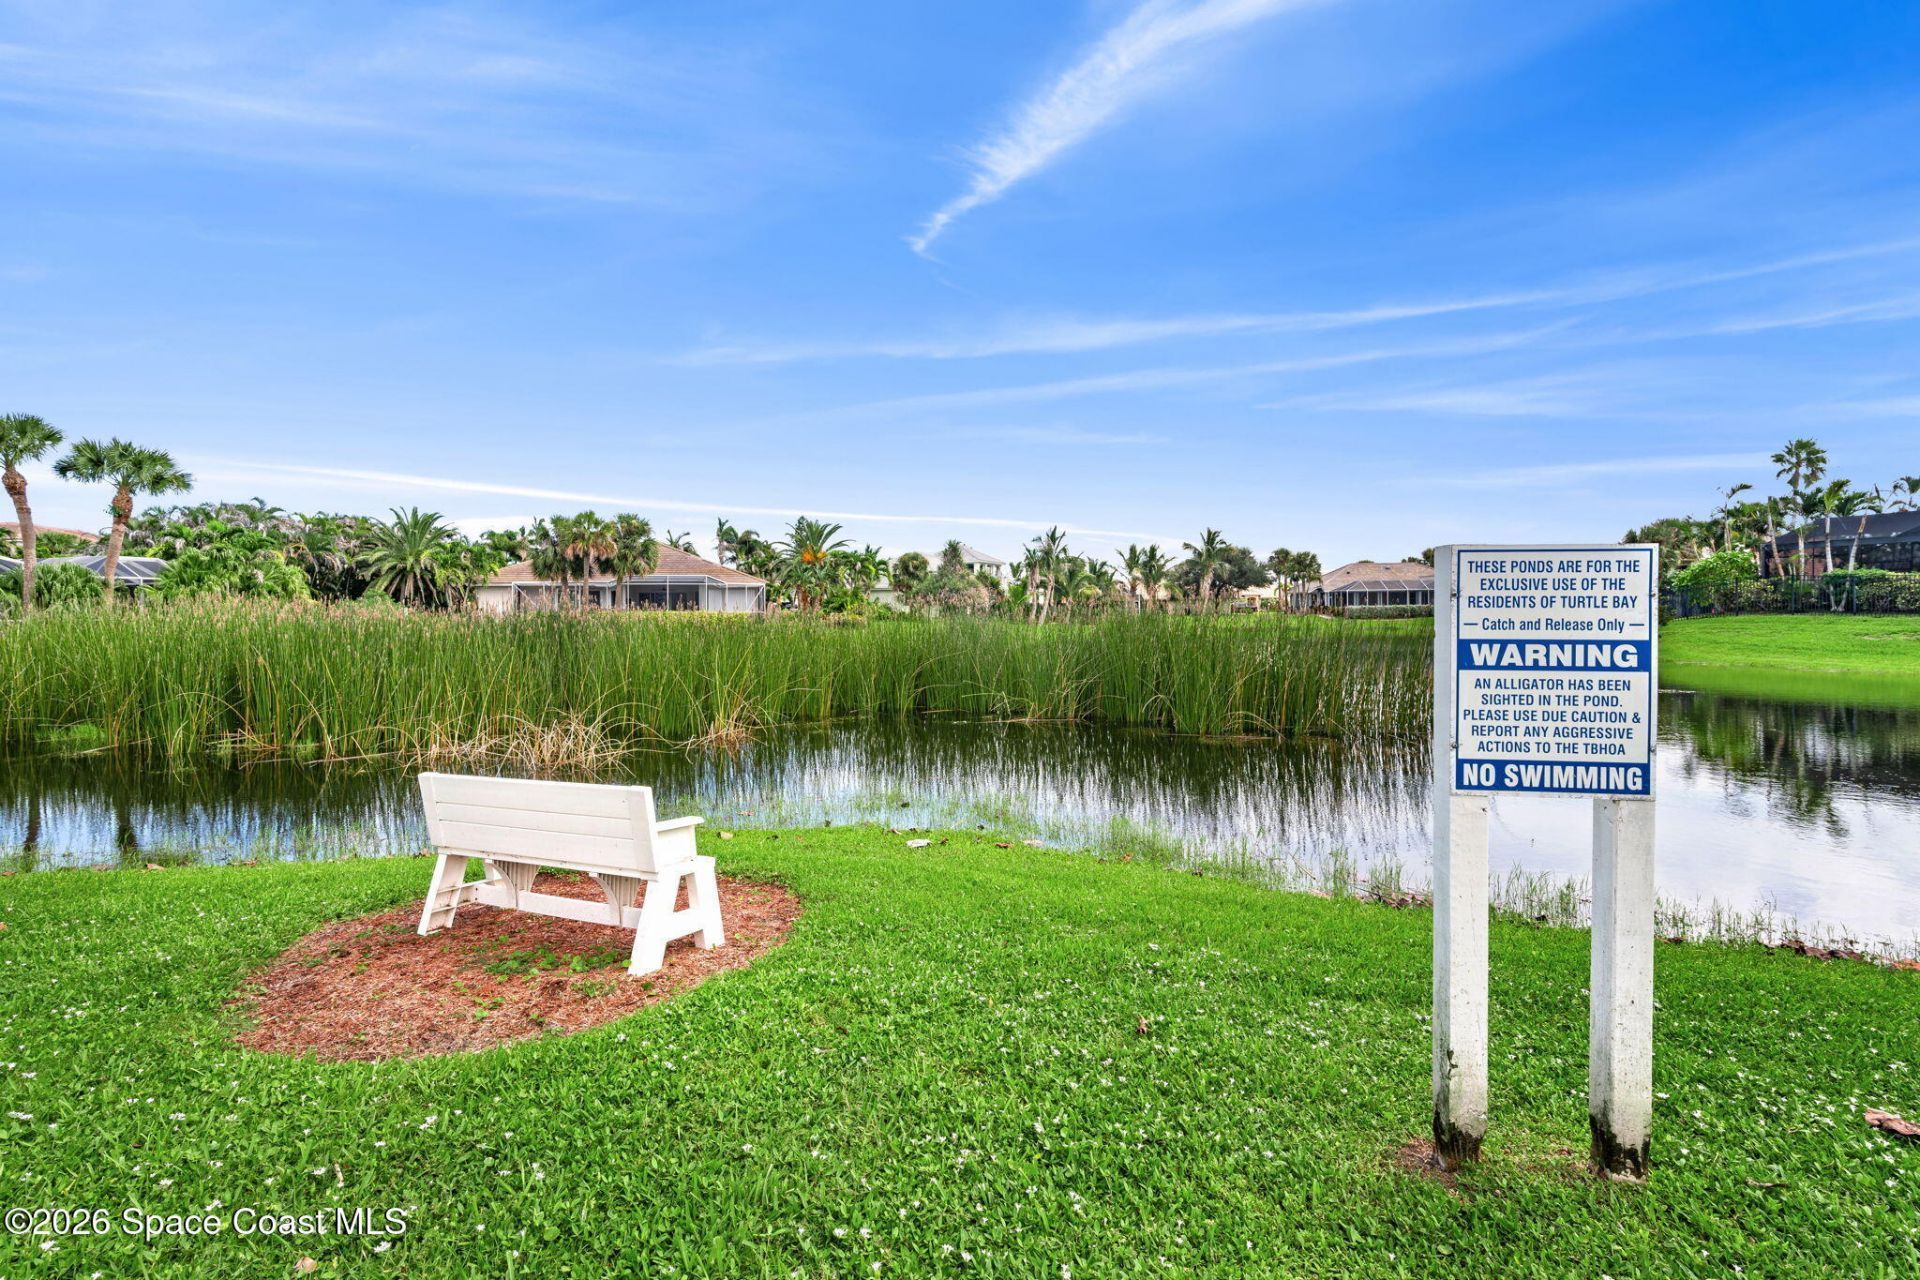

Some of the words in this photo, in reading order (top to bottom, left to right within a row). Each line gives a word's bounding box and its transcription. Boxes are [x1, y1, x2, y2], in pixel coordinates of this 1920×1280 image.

[1468, 561, 1506, 573] THESE
[1510, 560, 1553, 573] PONDS
[1558, 560, 1581, 572] ARE
[1587, 560, 1611, 572] FOR
[1615, 560, 1640, 572] THE
[1480, 578, 1548, 591] EXCLUSIVE
[1552, 578, 1576, 591] USE
[1581, 578, 1597, 591] OF
[1601, 578, 1625, 590] THE
[1468, 596, 1536, 608] RESIDENTS
[1540, 596, 1556, 608] OF
[1560, 596, 1608, 608] TURTLE
[1612, 596, 1638, 608] BAY
[1482, 618, 1515, 630] Catch
[1519, 618, 1540, 630] and
[1545, 618, 1593, 631] Release
[1598, 618, 1624, 633] Only
[1470, 643, 1638, 668] WARNING
[1474, 678, 1491, 689] AN
[1495, 678, 1564, 690] ALLIGATOR
[1568, 679, 1593, 690] HAS
[1599, 680, 1631, 691] BEEN
[1481, 694, 1534, 706] SIGHTED
[1539, 695, 1550, 706] IN
[1555, 695, 1579, 706] THE
[1584, 695, 1623, 707] POND.
[1463, 710, 1509, 721] PLEASE
[1513, 710, 1537, 722] USE
[1542, 711, 1567, 722] DUE
[1571, 711, 1627, 723] CAUTION
[1632, 712, 1641, 724] &
[1471, 726, 1519, 737] REPORT
[1524, 726, 1549, 738] ANY
[1553, 727, 1633, 739] AGGRESSIVE
[1478, 741, 1531, 753] ACTIONS
[1535, 742, 1549, 753] TO
[1555, 742, 1579, 754] THE
[1583, 743, 1626, 755] TBHOA
[1463, 763, 1496, 786] NO
[1504, 764, 1642, 790] SWIMMING
